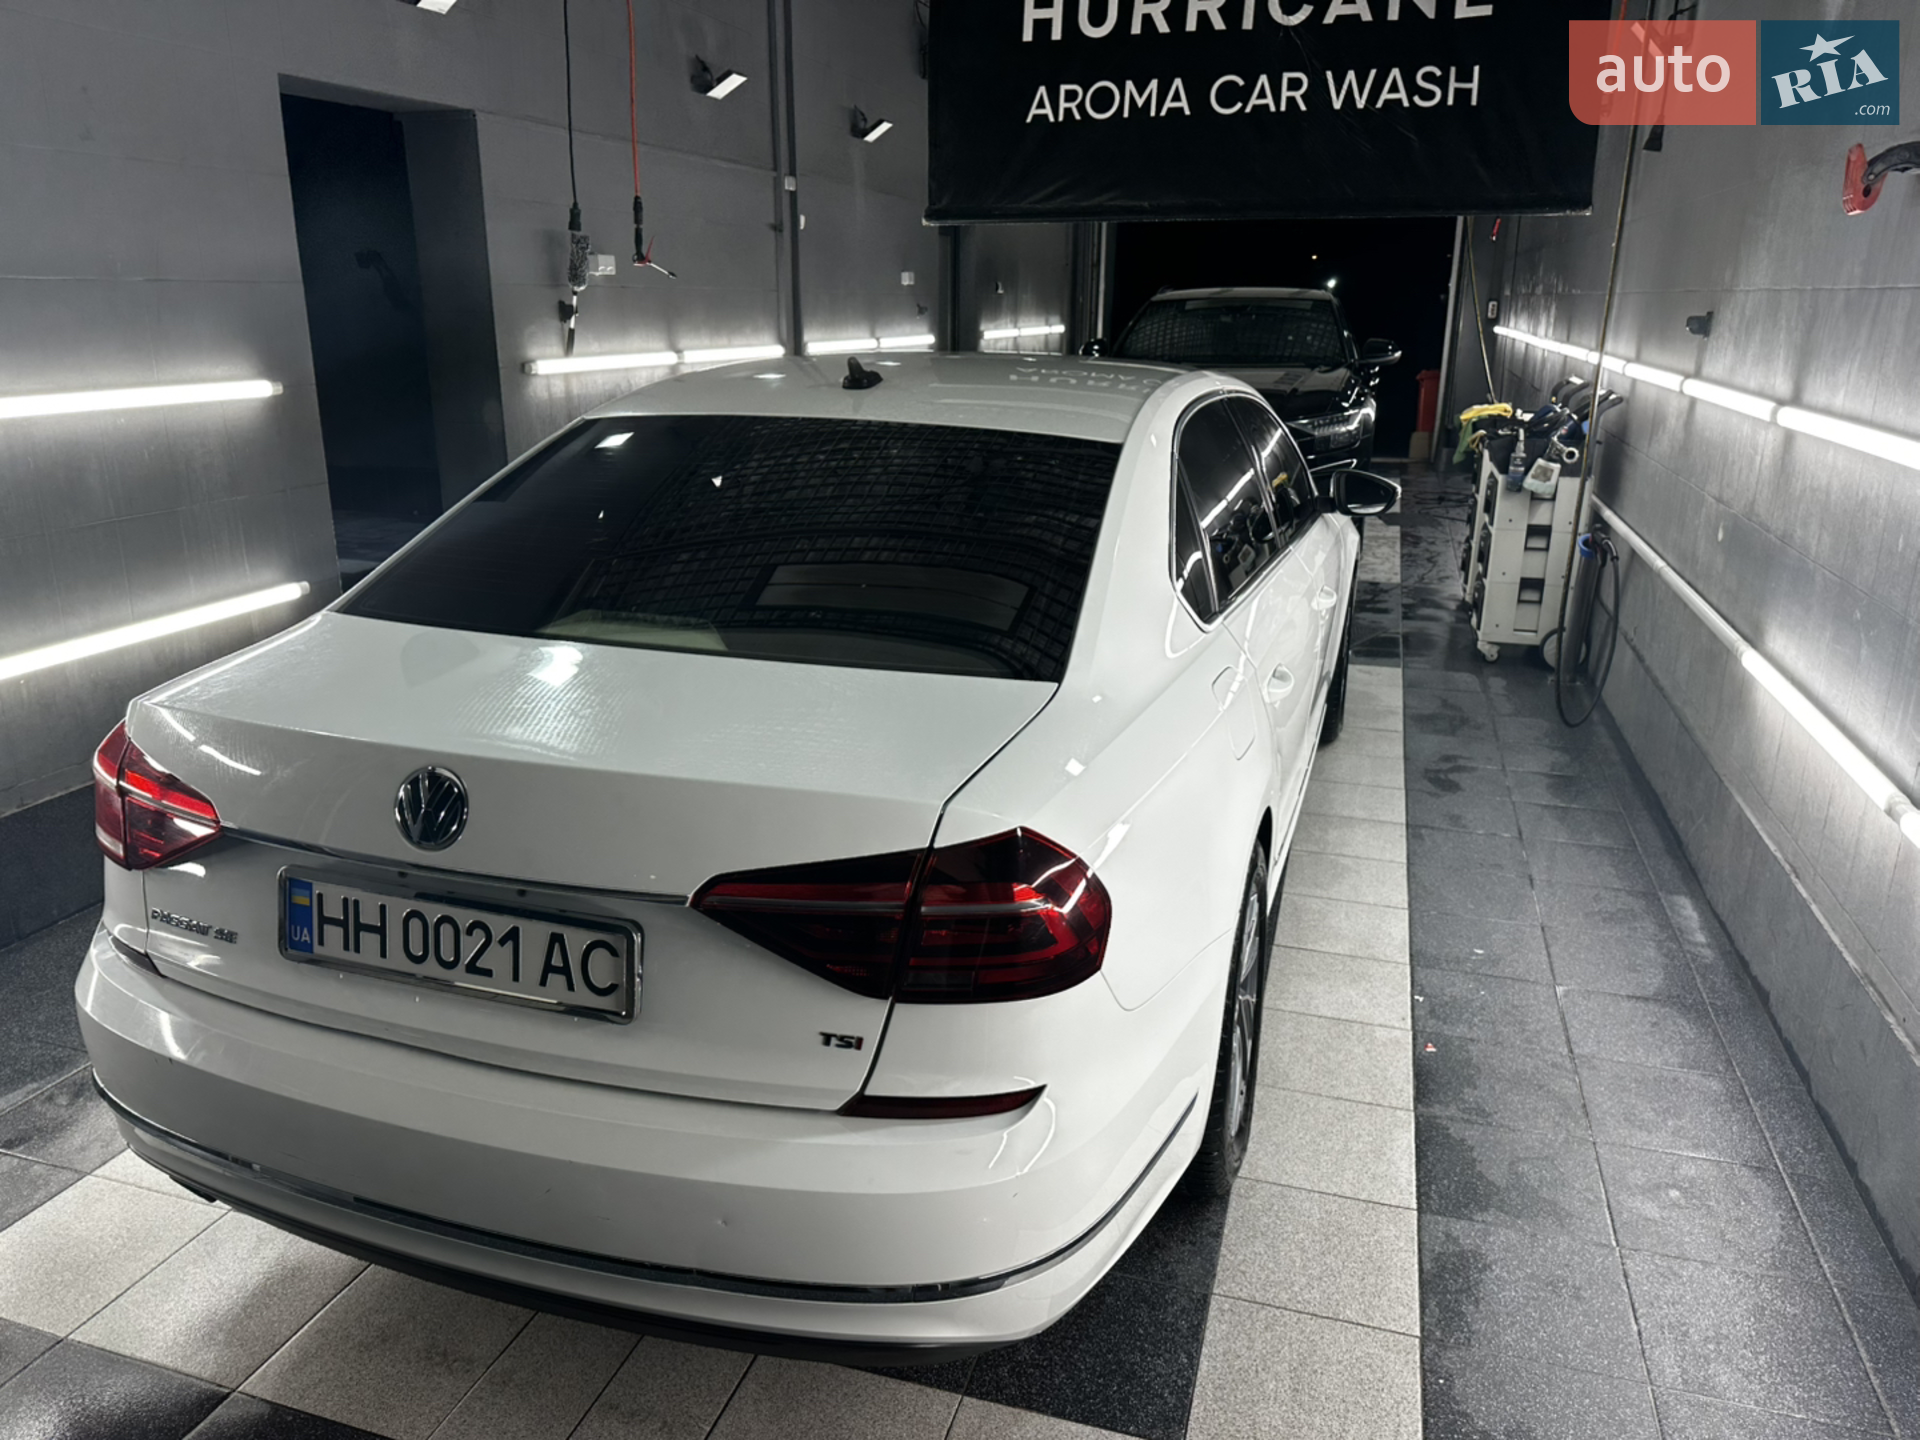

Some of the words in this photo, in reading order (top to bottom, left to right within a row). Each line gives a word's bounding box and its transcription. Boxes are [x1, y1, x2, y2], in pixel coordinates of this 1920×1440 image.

[1026, 77, 1191, 123] AROMA
[1209, 71, 1308, 115] CAR
[1325, 64, 1480, 110] WASH
[291, 924, 311, 944] UA
[315, 890, 389, 960] HH
[402, 907, 521, 983] 0021
[538, 931, 621, 997] AC
[819, 1031, 864, 1051] TSI
